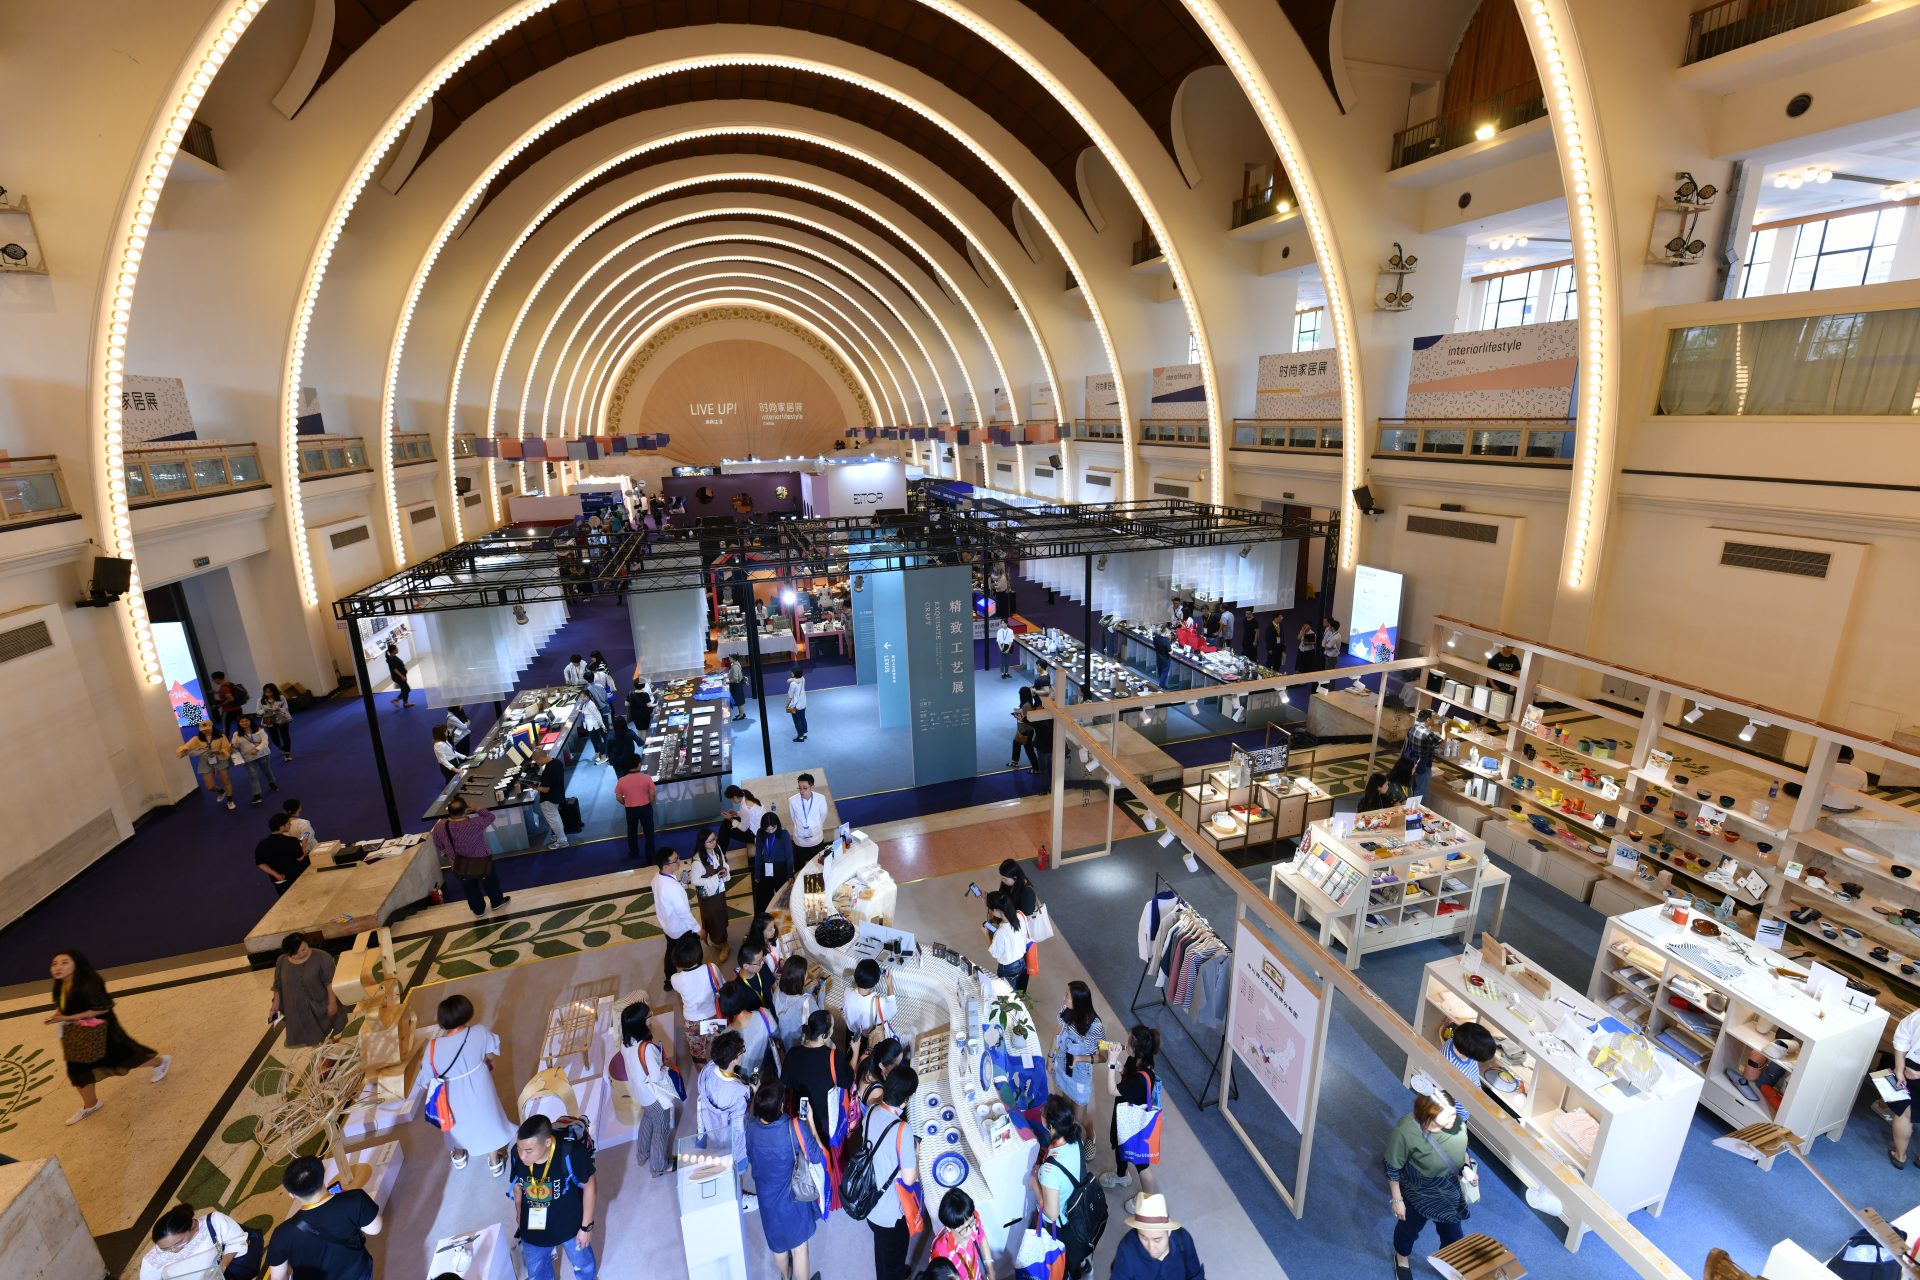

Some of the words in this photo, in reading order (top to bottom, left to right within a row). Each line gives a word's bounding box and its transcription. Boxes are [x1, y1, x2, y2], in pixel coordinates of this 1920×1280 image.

[1448, 339, 1522, 356] interiorlifestyle
[1278, 361, 1328, 378] 时尚家居展
[1447, 358, 1466, 366] CHINA
[690, 403, 715, 415] LIVE
[717, 402, 737, 415] UP!
[934, 601, 942, 641] EXQUISITE
[949, 599, 965, 694] 精致工艺展
[553, 1178, 561, 1200] GUCCI
